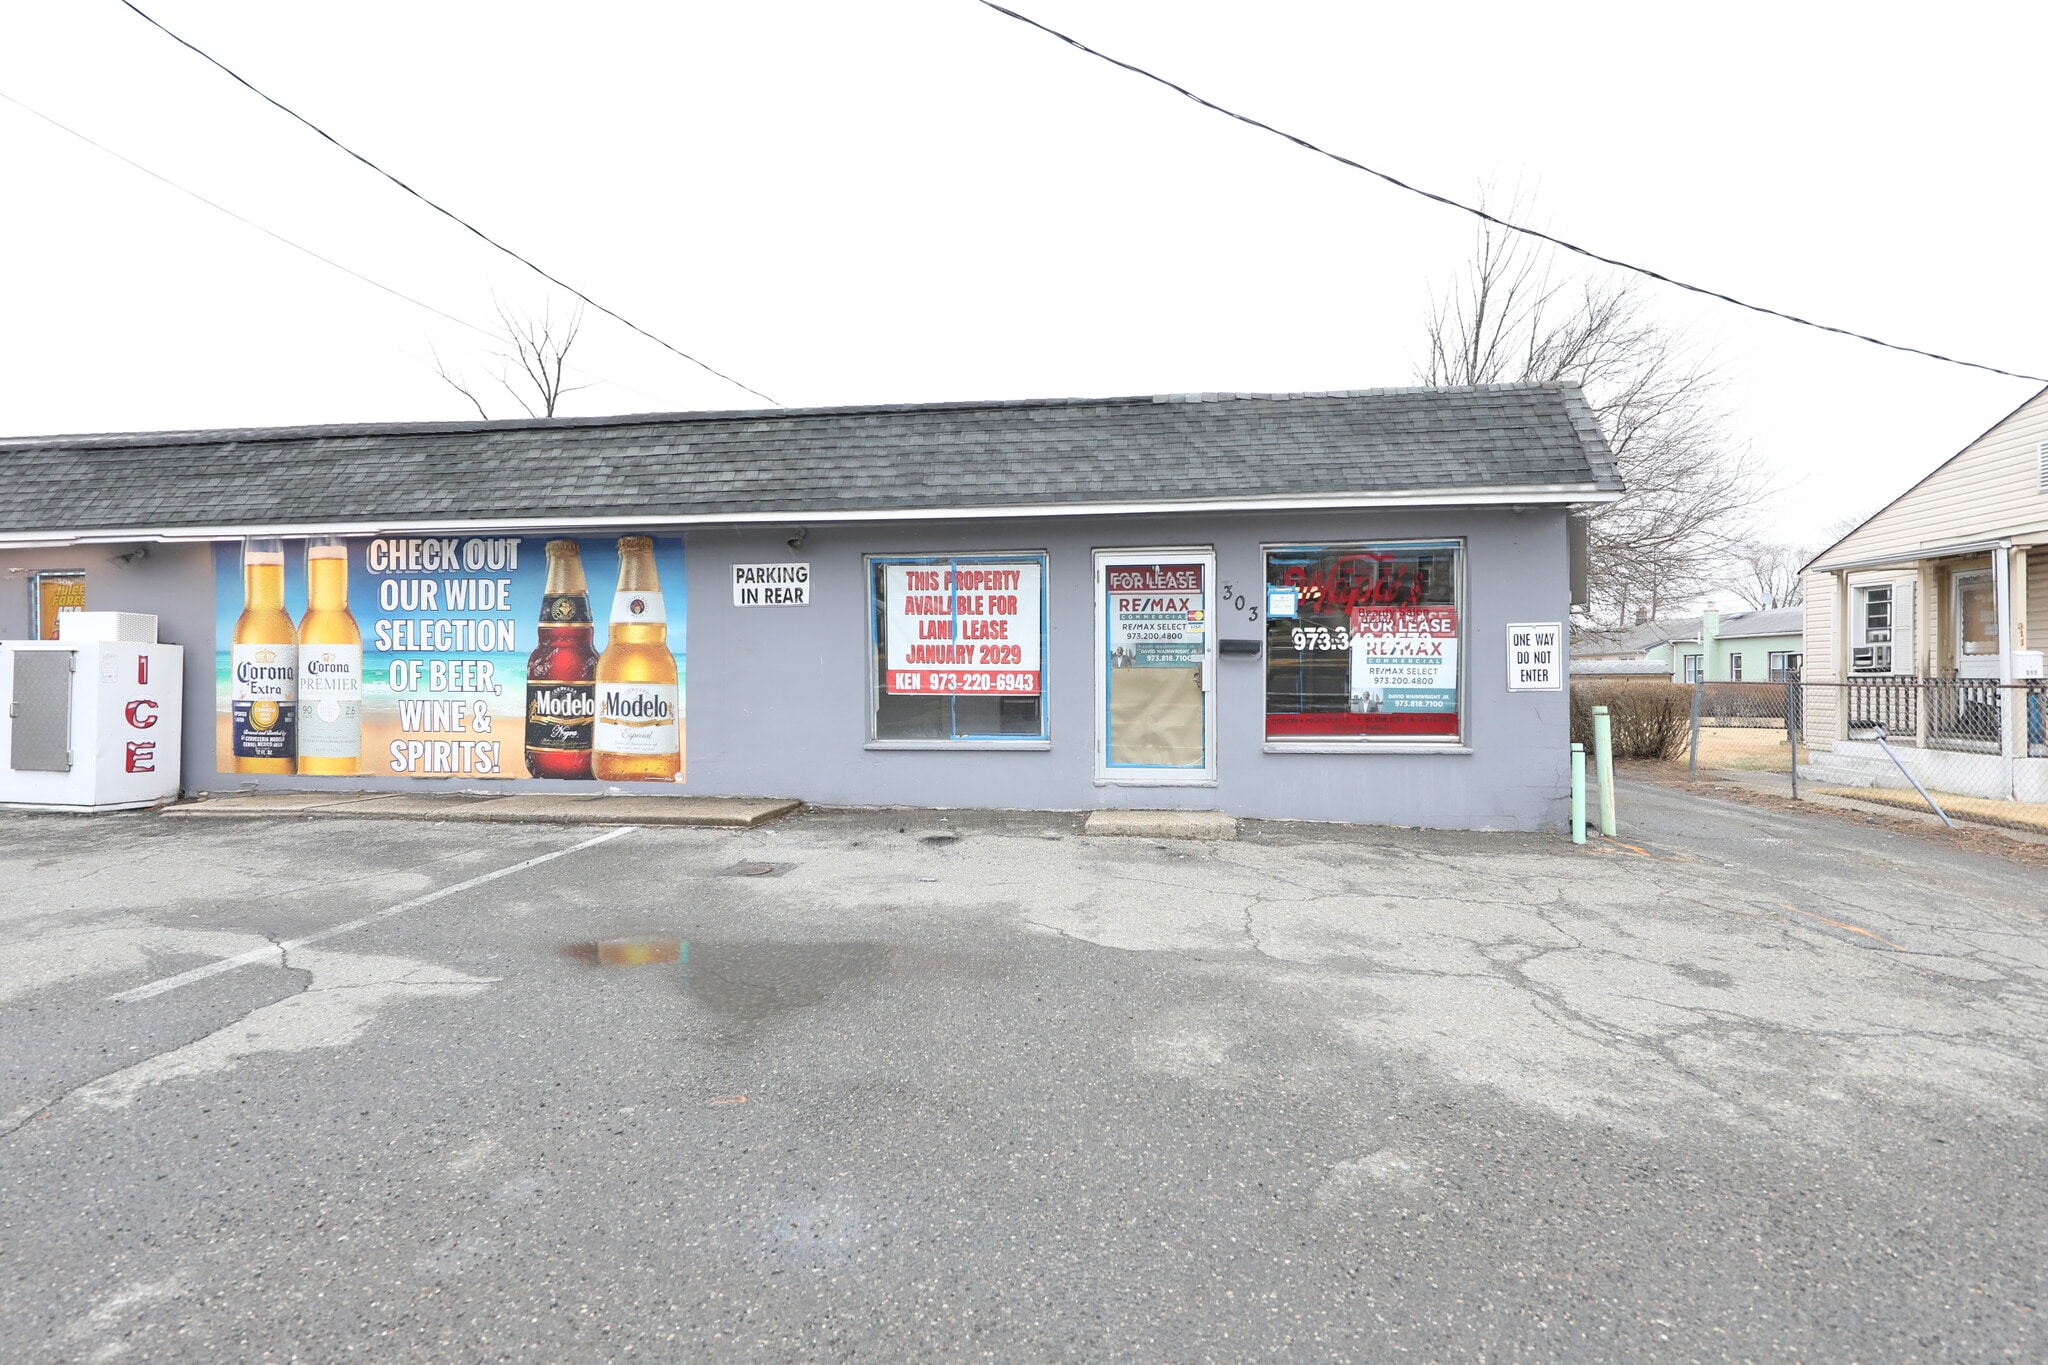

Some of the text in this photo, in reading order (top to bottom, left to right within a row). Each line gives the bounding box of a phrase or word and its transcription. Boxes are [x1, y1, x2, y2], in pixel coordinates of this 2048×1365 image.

[368, 538, 521, 572] CHECK OUT
[736, 566, 808, 584] PARKING
[906, 570, 1021, 591] THIS PROPERTY
[1112, 575, 1197, 589] FOR LEASE
[56, 585, 85, 595] JUICE
[380, 578, 511, 612] OUR WIDE
[741, 587, 804, 604] IN REAR
[52, 596, 86, 606] FORCE
[905, 595, 1018, 615] AVAILABLE FOR
[1119, 598, 1190, 612] RE/MAX
[1223, 584, 1258, 621] 303
[962, 620, 1008, 640] LEASE
[1122, 623, 1187, 631] RE/MAX SELECT
[1360, 619, 1451, 632] FOR LEASE
[374, 618, 515, 652] SELECTION
[1513, 633, 1554, 646] ONE WAY
[906, 644, 1022, 664] JANUARY 2029
[1517, 651, 1551, 664] DO NOT
[237, 661, 294, 685] Corona
[308, 660, 349, 677] Corona
[389, 659, 502, 696] OF BEER,
[1369, 667, 1438, 675] RE/MAX SELECT
[1521, 669, 1549, 682] ENTER
[250, 681, 282, 695] Extra
[300, 678, 358, 690] PREMIER
[895, 673, 1034, 691] KEN 973-220-6943
[1374, 677, 1433, 685] 973.200.4800
[537, 690, 595, 717] Modelo
[606, 692, 667, 718] Modelo
[125, 655, 158, 773] ICE
[398, 700, 492, 733] WINE &
[621, 728, 654, 741] Especial
[389, 739, 500, 773] SPIRITS!
